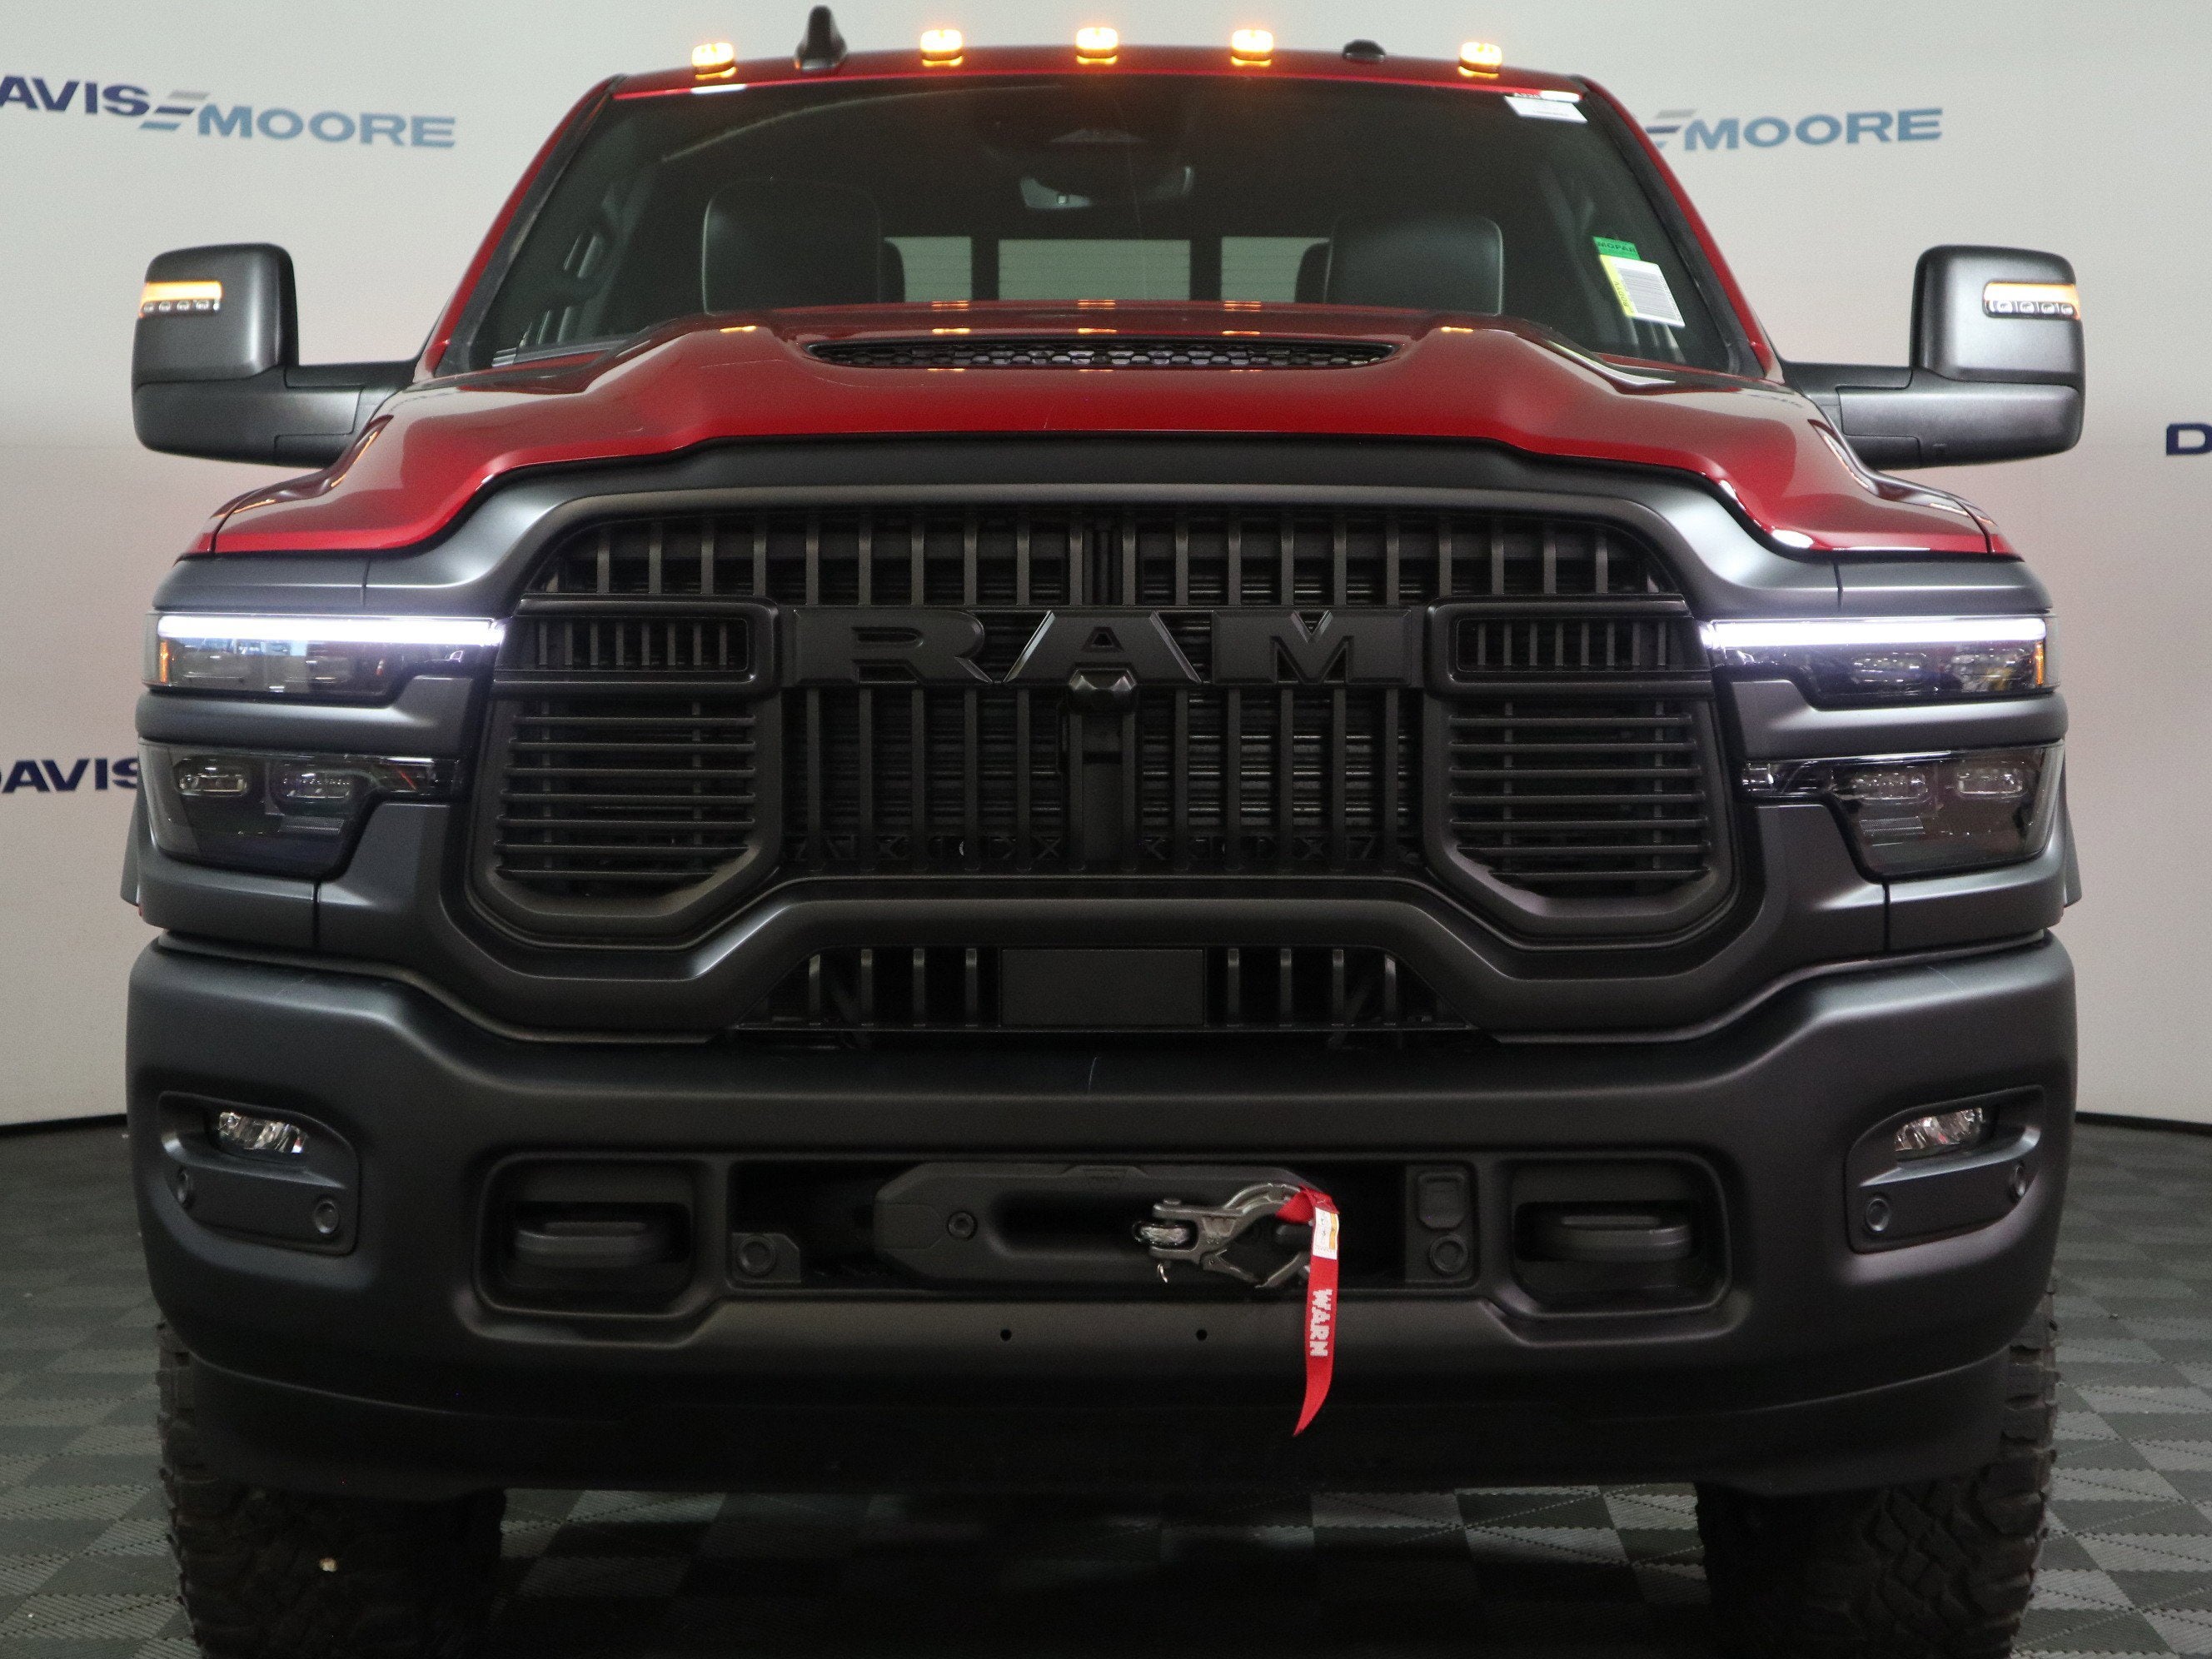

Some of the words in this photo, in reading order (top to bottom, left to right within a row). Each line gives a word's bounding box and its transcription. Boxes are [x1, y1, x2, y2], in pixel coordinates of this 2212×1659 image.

[197, 103, 456, 148] MOORE
[1684, 107, 1943, 151] MOORE
[793, 610, 1412, 685] RAM
[0, 757, 138, 793] AVIS
[1309, 1288, 1333, 1357] WARN
